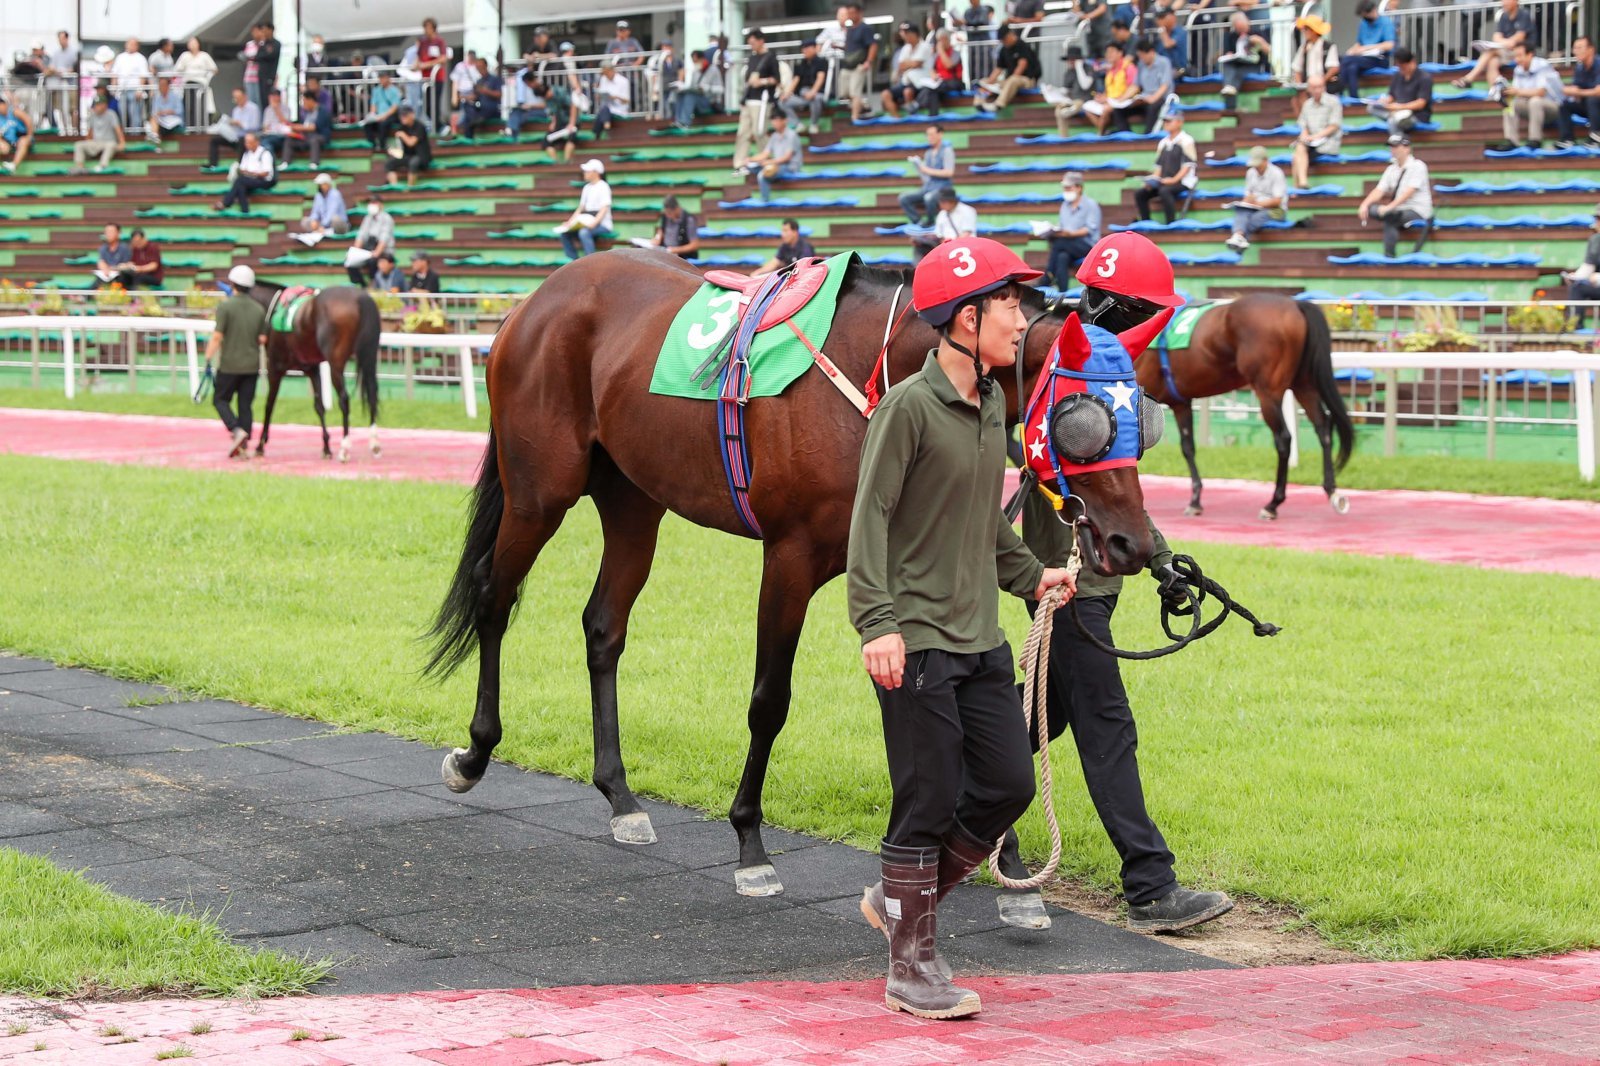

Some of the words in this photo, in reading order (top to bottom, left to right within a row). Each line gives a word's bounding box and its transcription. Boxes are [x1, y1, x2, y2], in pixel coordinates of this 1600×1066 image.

[948, 246, 977, 278] 3
[1096, 248, 1120, 278] 3
[688, 291, 742, 350] 3
[1175, 307, 1199, 335] 2
